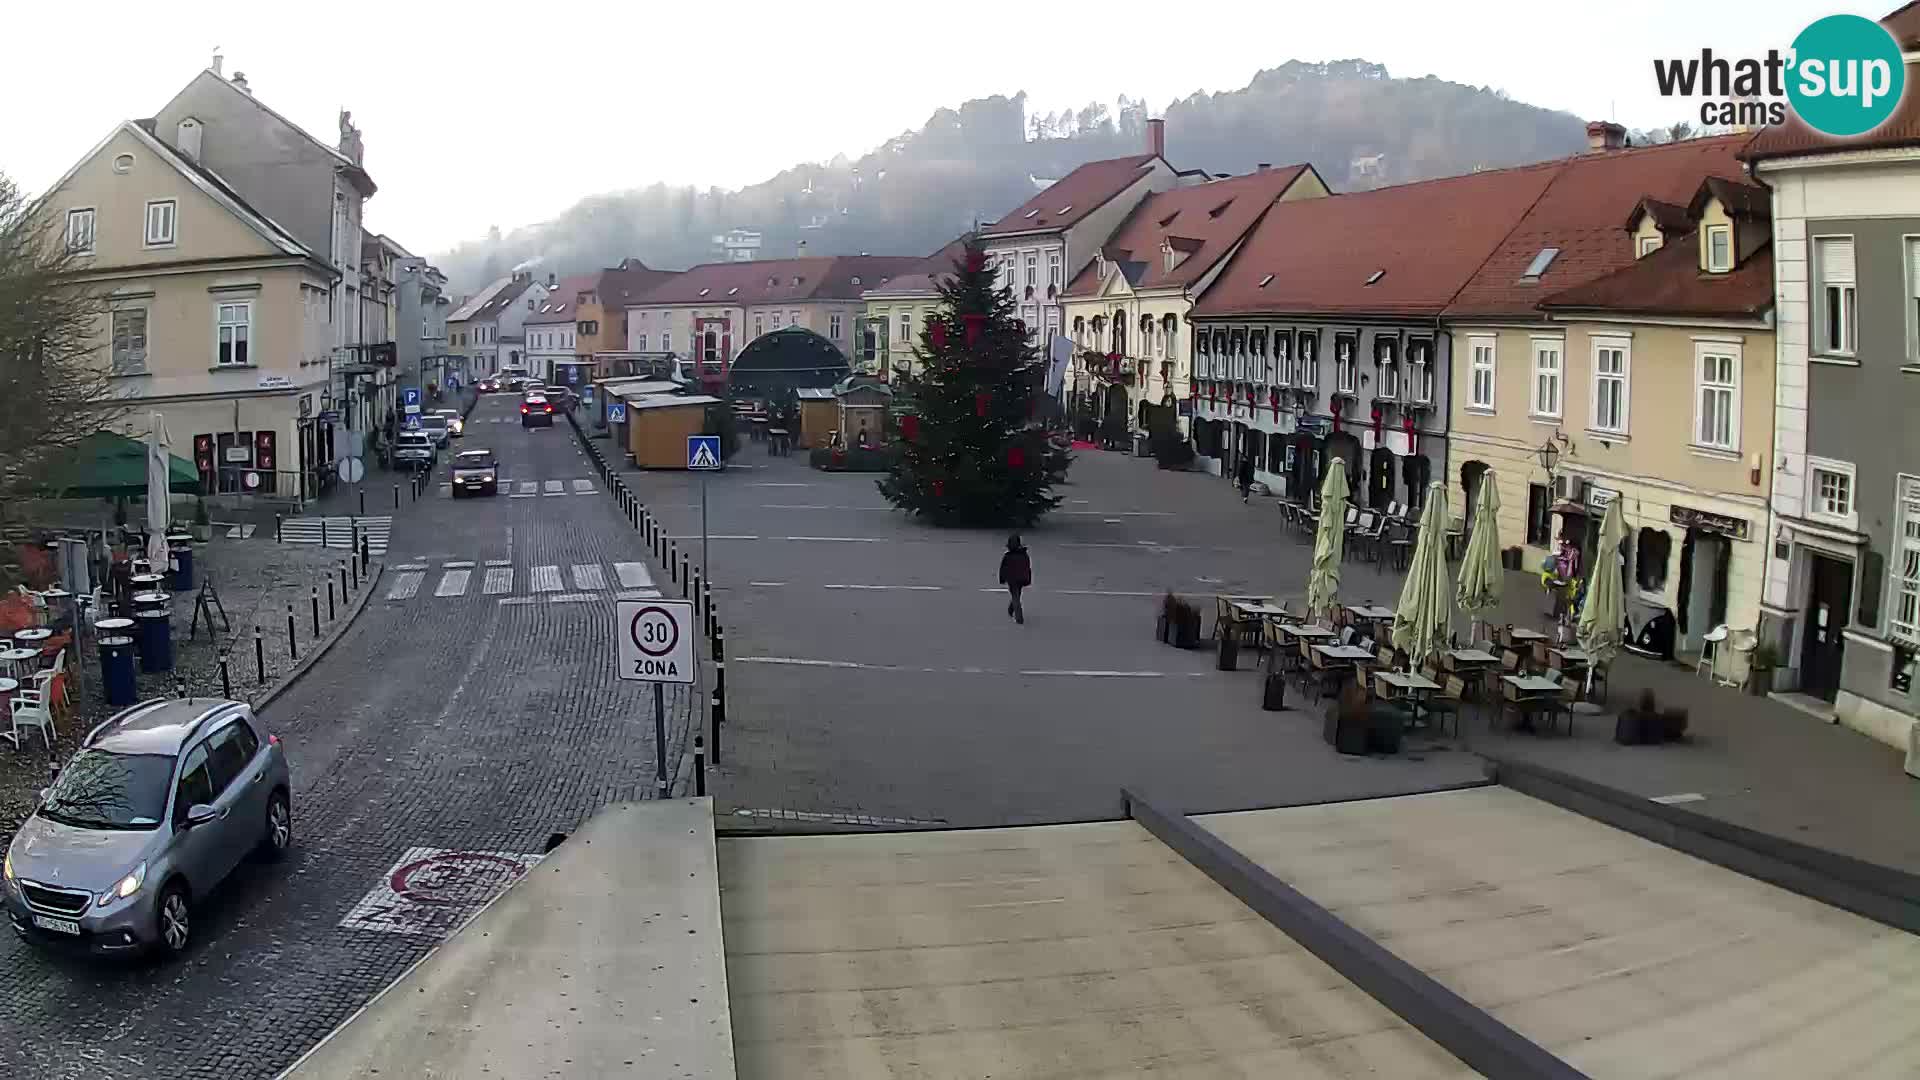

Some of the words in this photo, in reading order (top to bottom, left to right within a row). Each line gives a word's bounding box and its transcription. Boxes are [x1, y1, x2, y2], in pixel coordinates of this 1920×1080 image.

[408, 391, 416, 403] P
[643, 622, 667, 643] 30
[633, 659, 678, 677] ZONA
